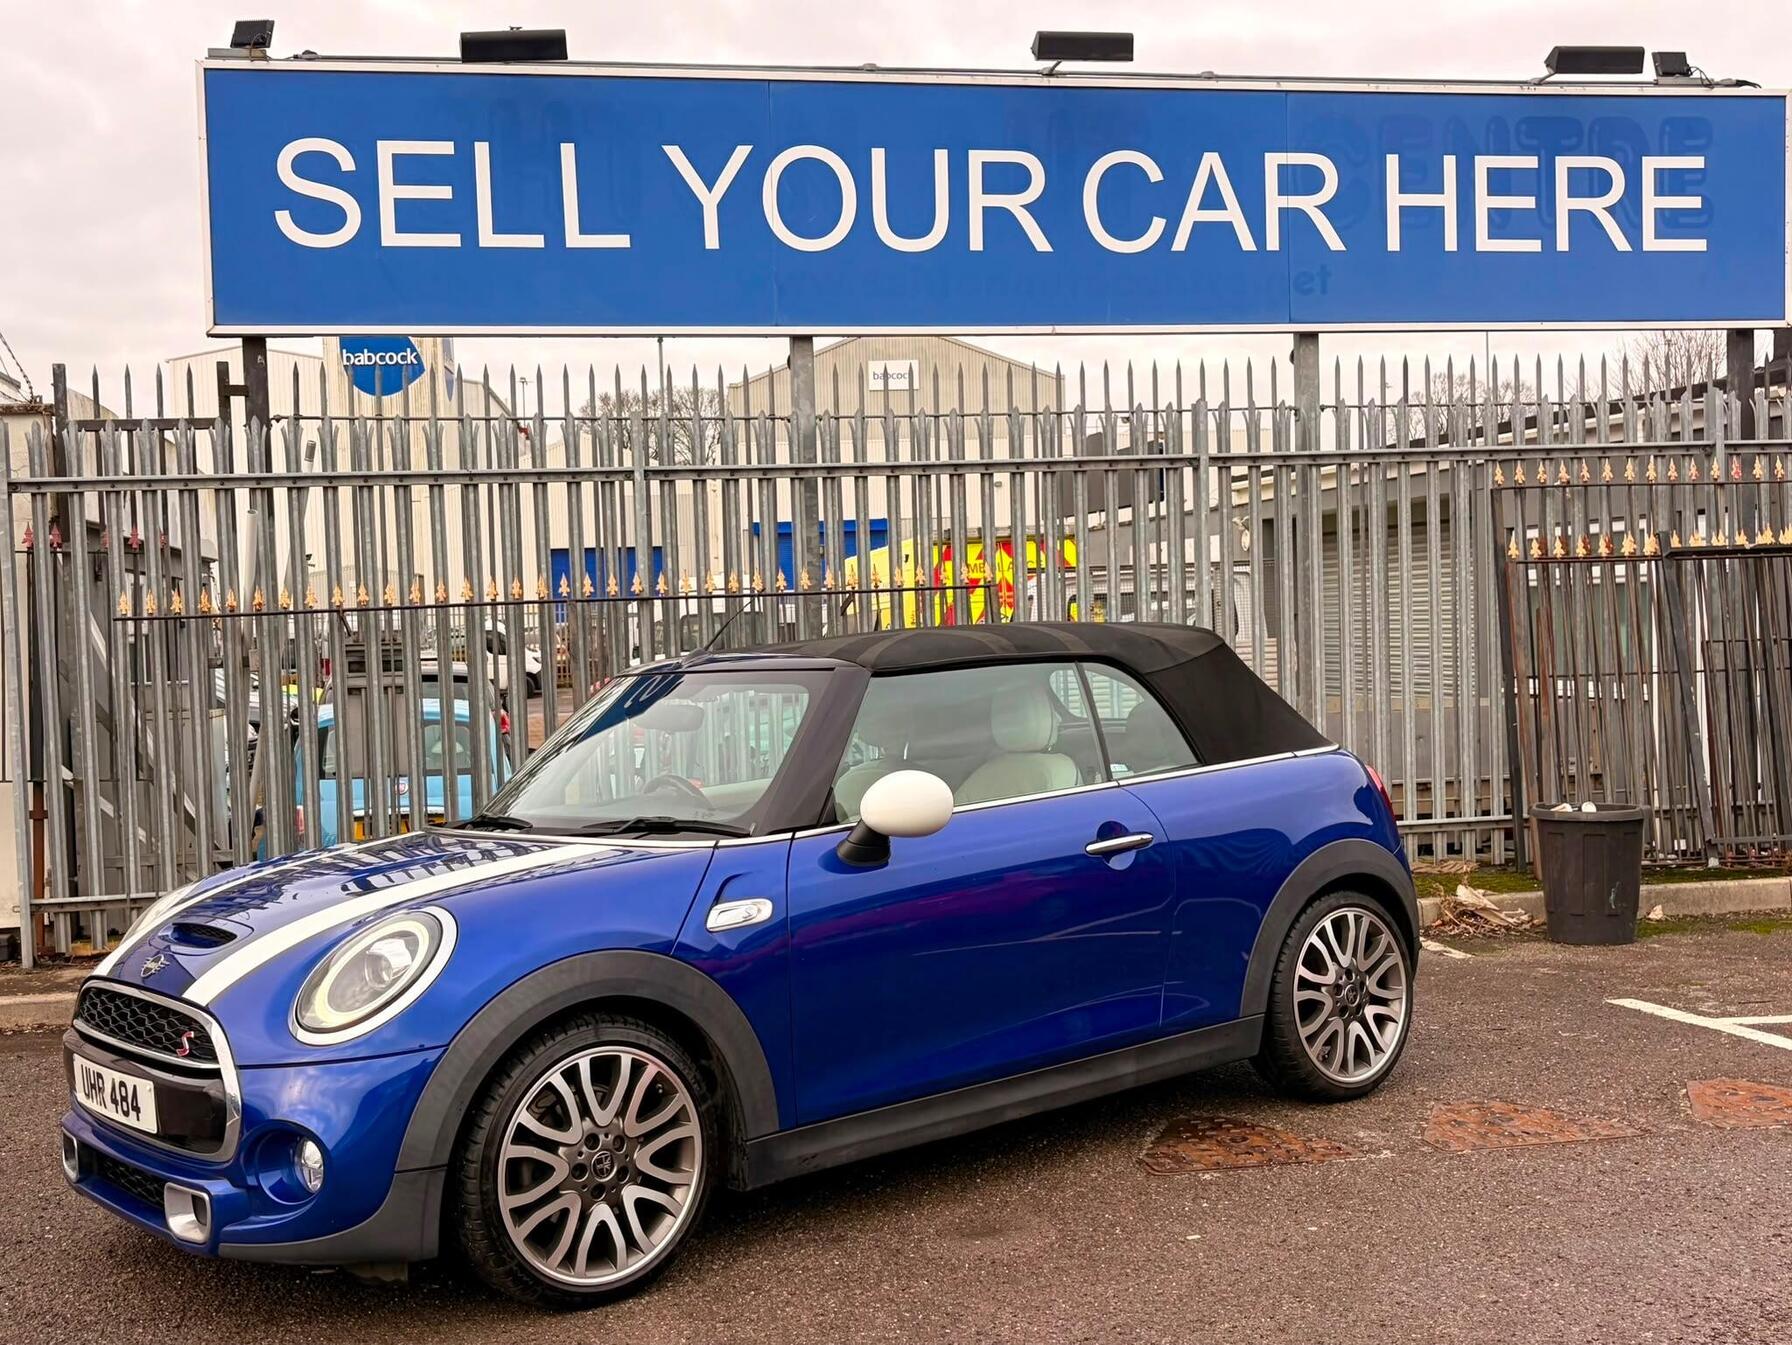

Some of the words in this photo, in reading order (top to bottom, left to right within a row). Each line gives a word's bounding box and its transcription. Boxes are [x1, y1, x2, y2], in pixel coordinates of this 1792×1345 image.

[275, 138, 630, 248] SELL
[662, 145, 1053, 252] YOUR
[1083, 150, 1346, 253] CAR
[1387, 154, 1708, 252] HERE
[342, 348, 418, 366] babcock
[873, 371, 914, 380] babcoc
[81, 1064, 107, 1109] UHR
[110, 1078, 141, 1122] 484
